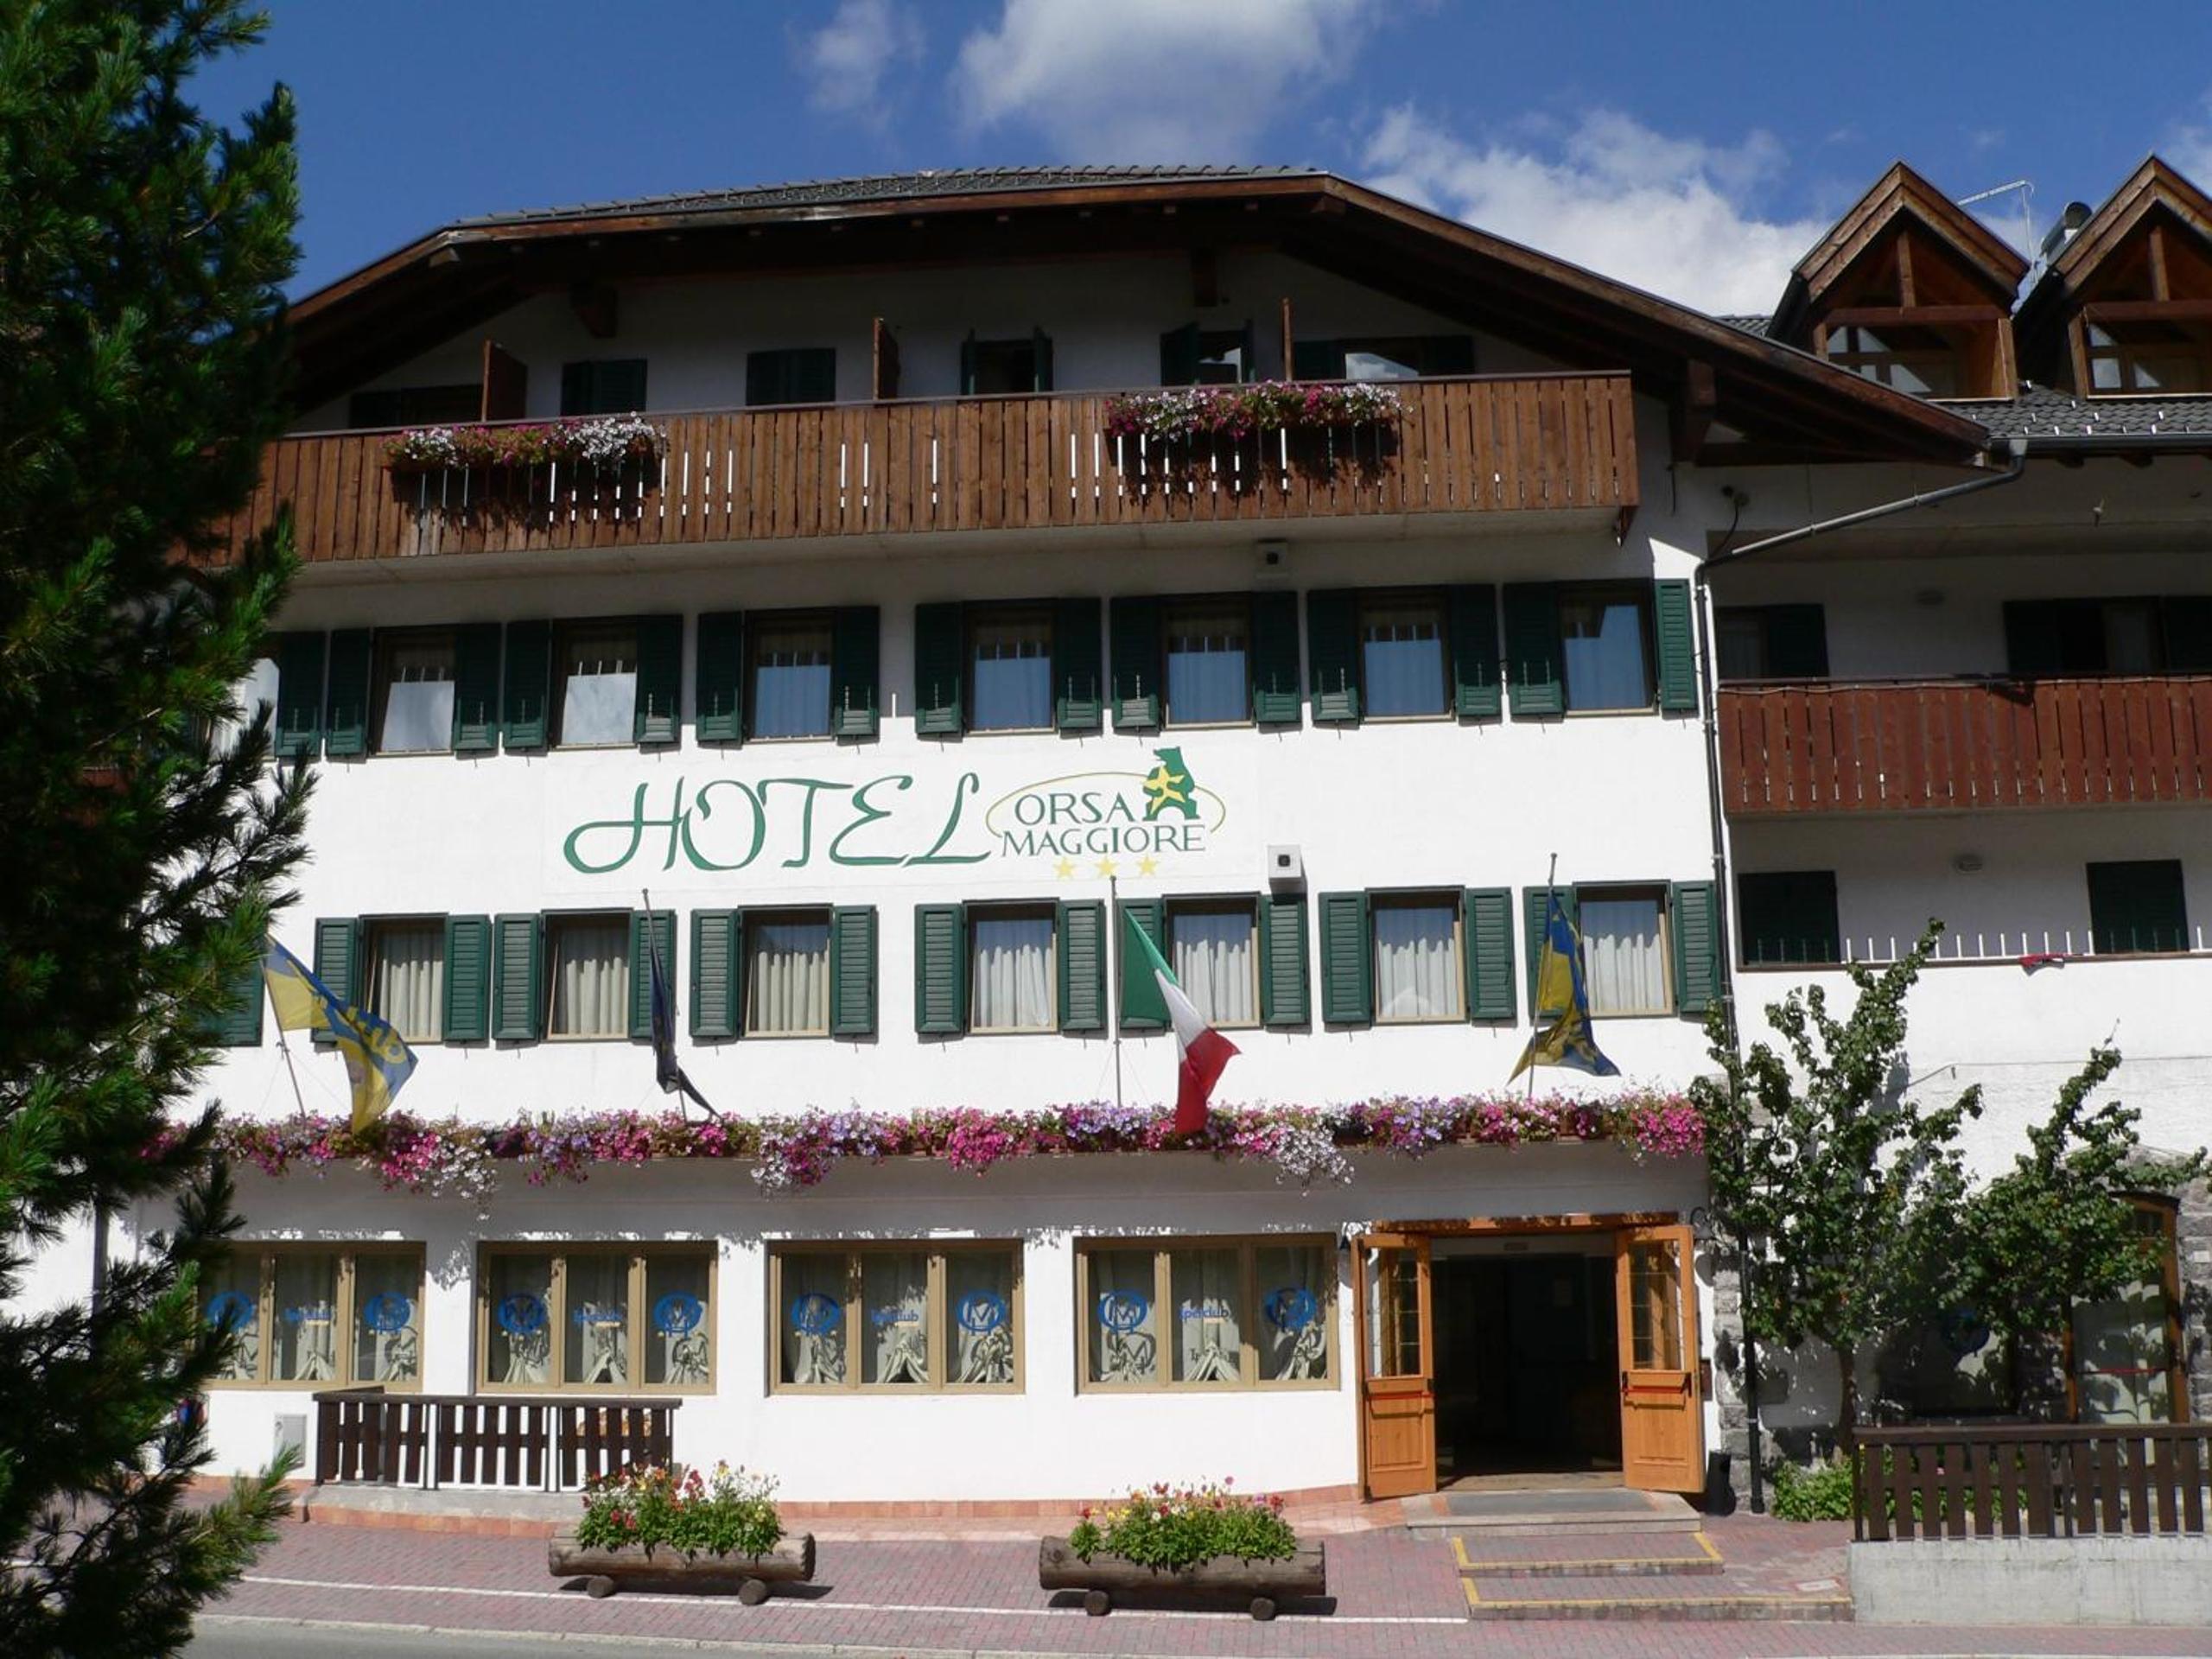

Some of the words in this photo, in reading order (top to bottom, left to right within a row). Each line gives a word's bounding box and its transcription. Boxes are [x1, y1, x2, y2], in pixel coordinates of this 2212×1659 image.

[563, 773, 991, 873] HOTEL
[1014, 793, 1135, 824] ORSA
[1003, 825, 1205, 855] MAGGIORE
